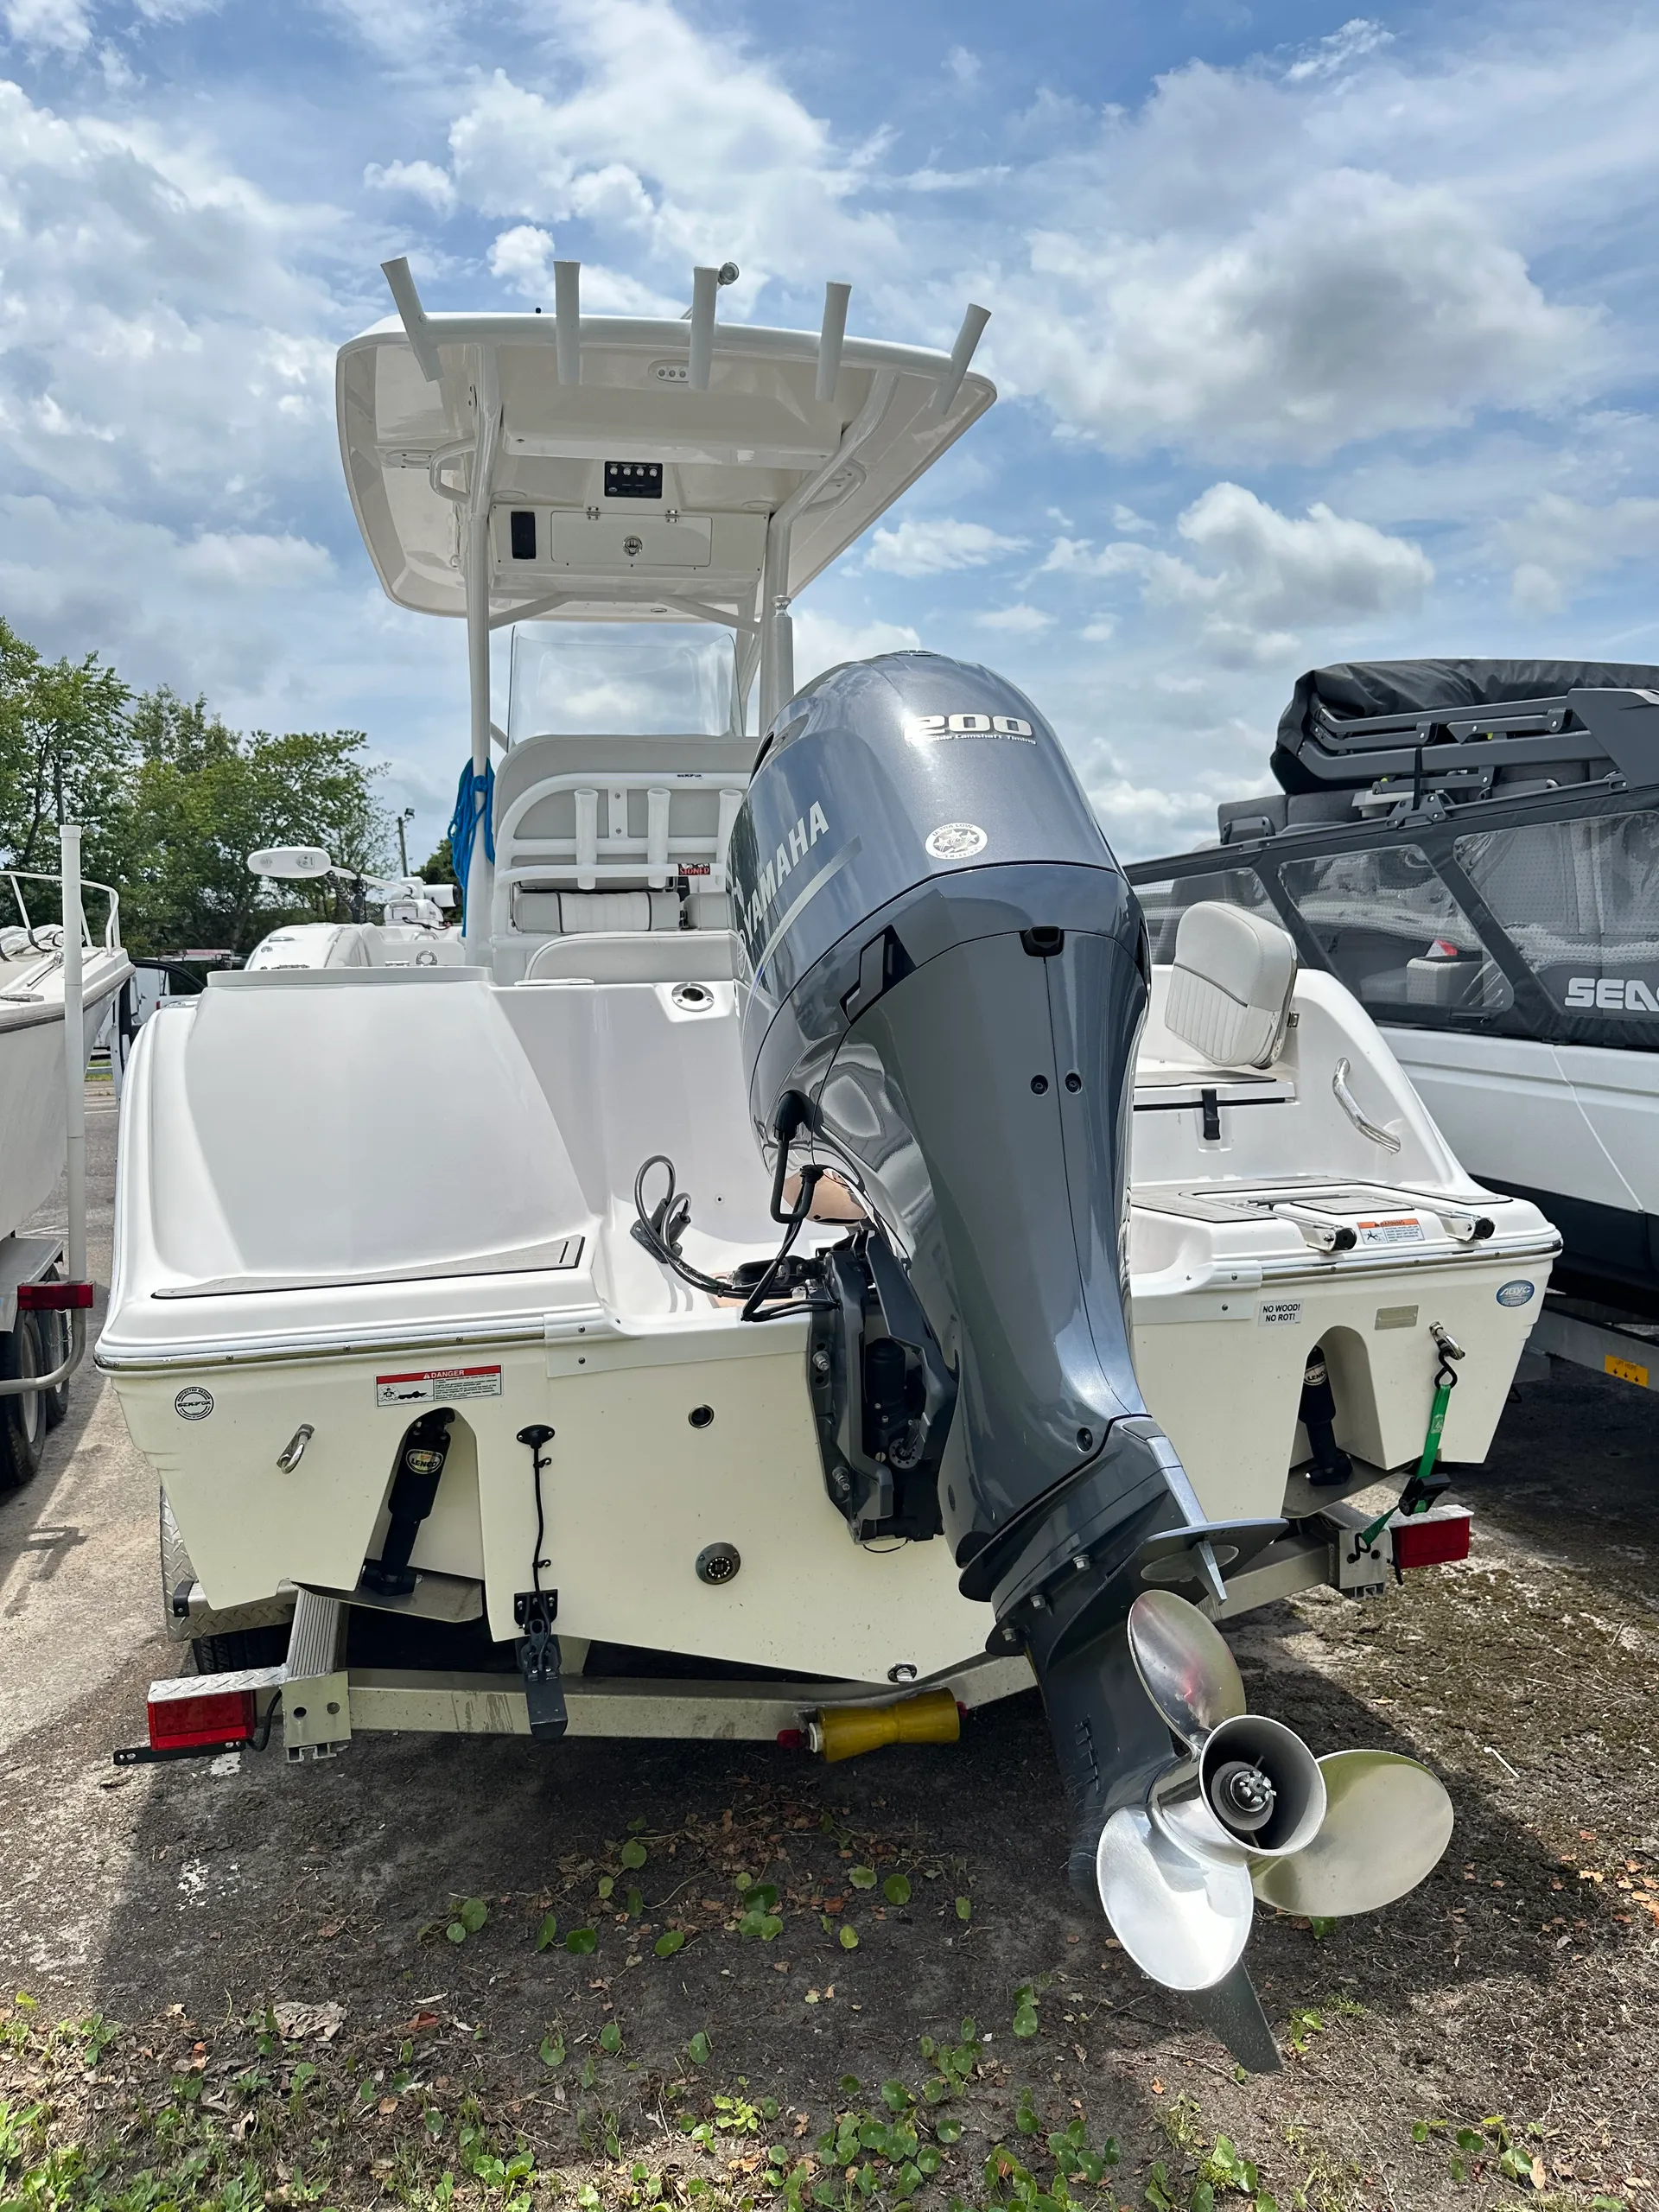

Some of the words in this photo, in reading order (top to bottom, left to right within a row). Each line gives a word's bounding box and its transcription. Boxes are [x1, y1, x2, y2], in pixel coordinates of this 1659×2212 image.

[905, 714, 1033, 736] 200
[932, 824, 953, 836] ULTRA
[743, 800, 830, 946] YAMAHA
[1565, 977, 1659, 1012] SEA
[1275, 1303, 1300, 1313] WOOD!
[432, 1370, 464, 1378] DANGER
[411, 1458, 437, 1467] LENCO
